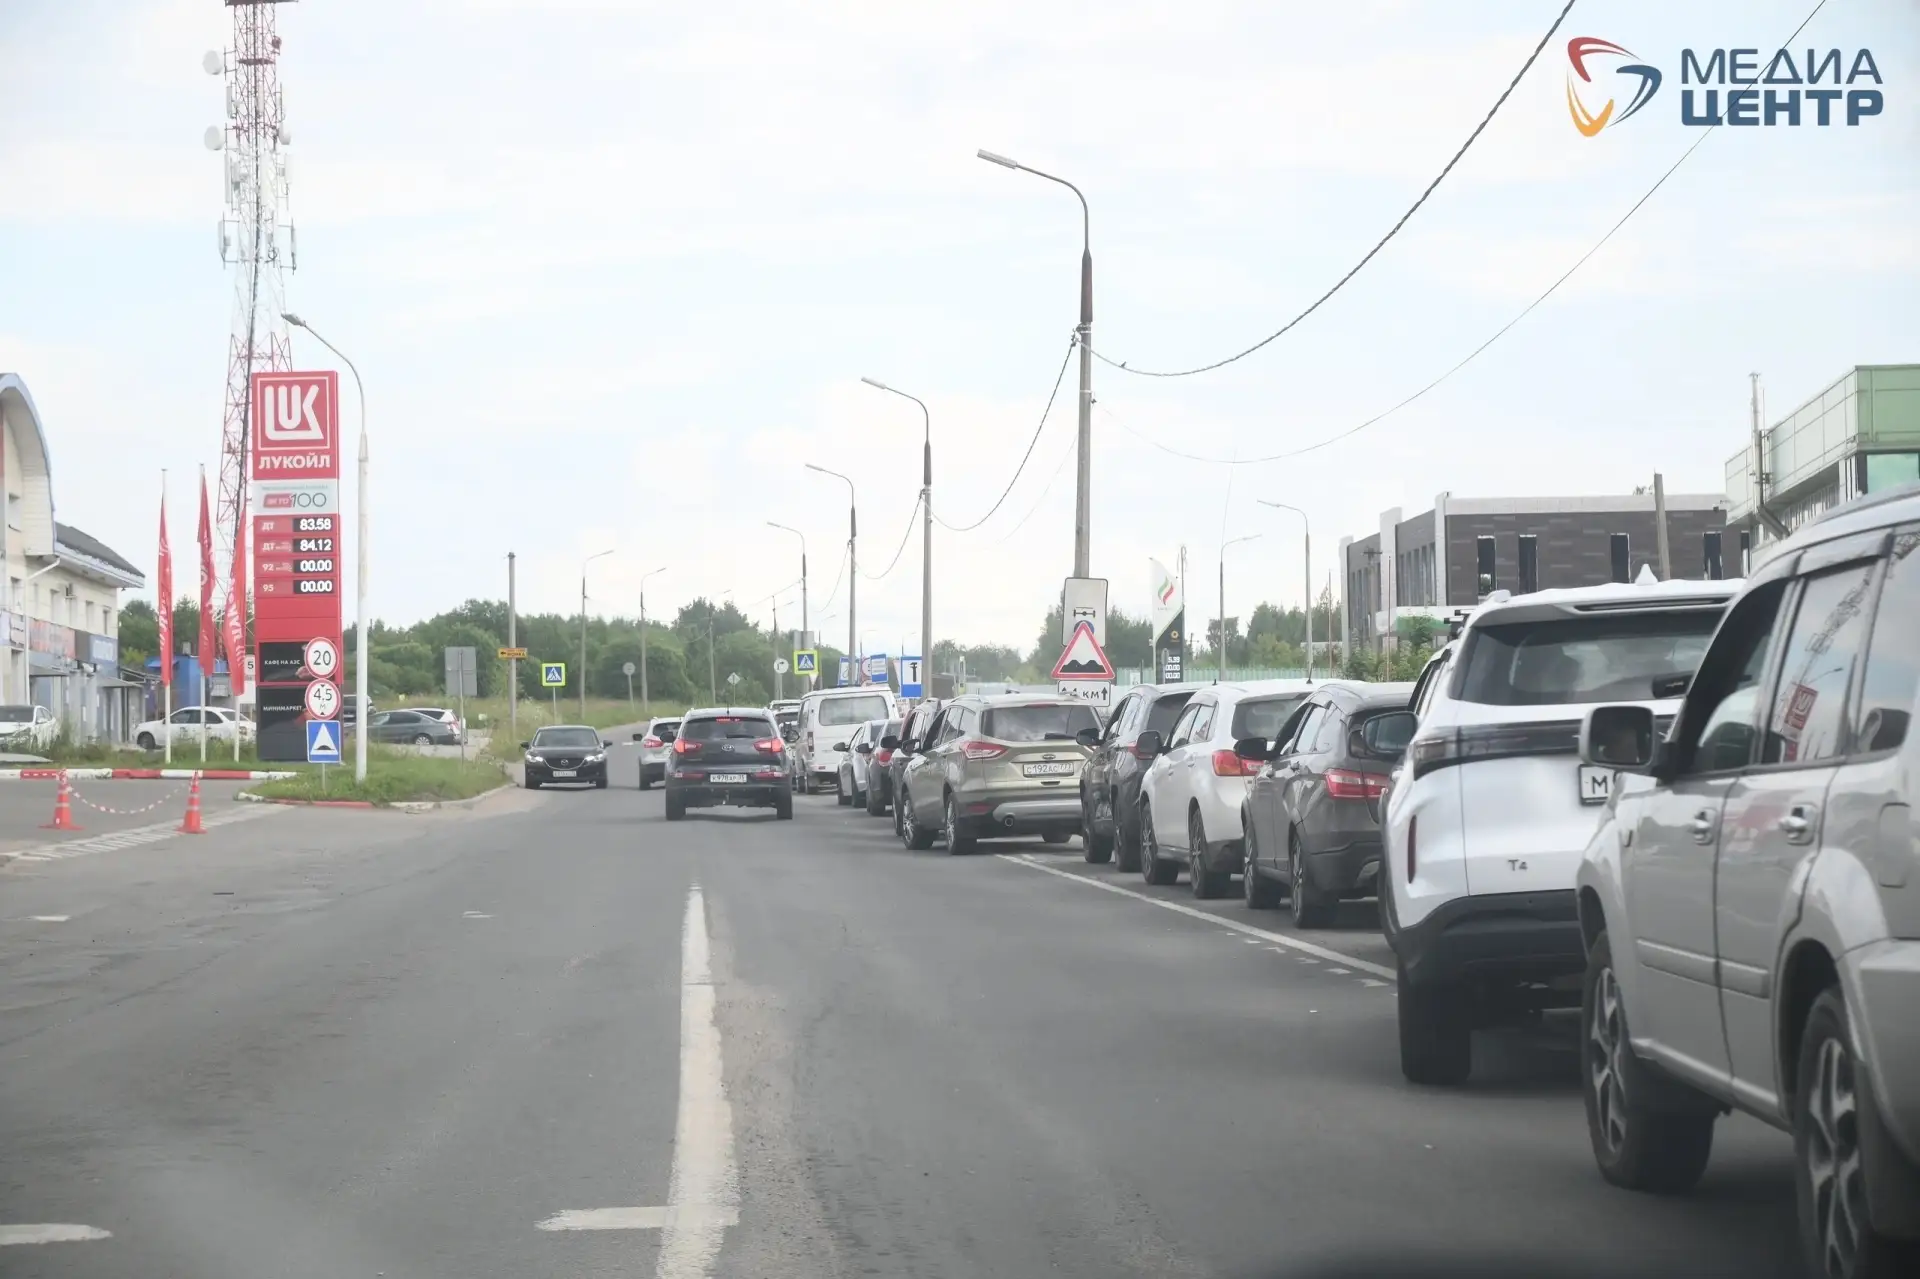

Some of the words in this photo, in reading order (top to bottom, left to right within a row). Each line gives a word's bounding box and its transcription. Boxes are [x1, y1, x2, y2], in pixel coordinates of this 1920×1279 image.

[259, 452, 330, 469] ЛУКОЙЛ
[300, 518, 332, 531] 83.58
[300, 539, 332, 551] 84.12
[262, 563, 274, 571] 92
[300, 559, 333, 572] 00.00
[262, 584, 274, 592] 95
[300, 580, 333, 593] 00.00
[313, 650, 332, 666] 20
